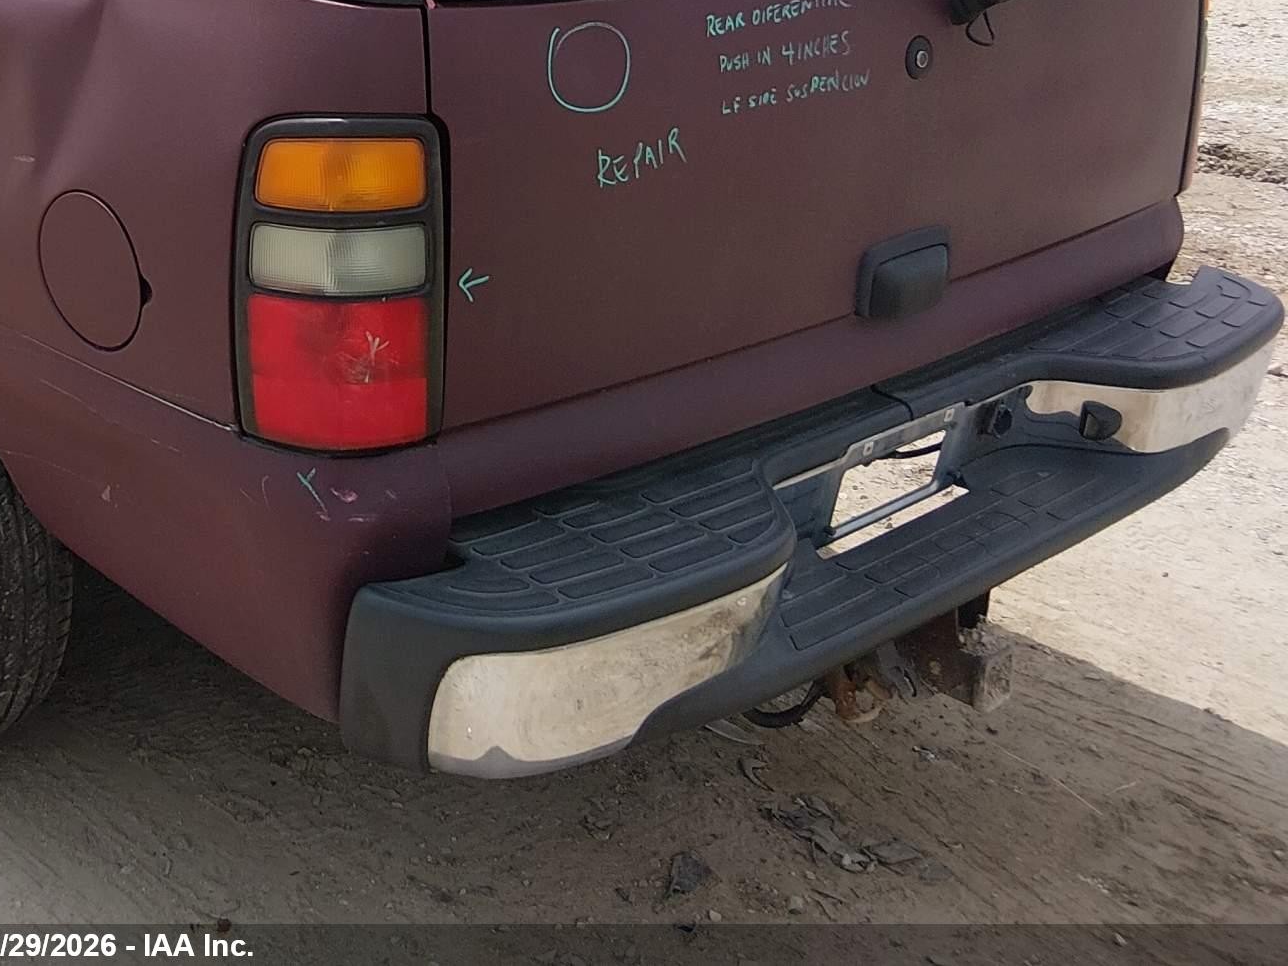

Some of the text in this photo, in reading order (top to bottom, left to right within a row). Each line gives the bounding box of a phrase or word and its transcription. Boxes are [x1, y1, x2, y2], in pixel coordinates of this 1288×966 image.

[706, 12, 746, 38] REAR
[719, 54, 749, 72] PUSH
[757, 45, 771, 65] IN
[722, 97, 741, 114] LF
[748, 88, 777, 108] SIDE
[597, 127, 687, 188] REPAIR
